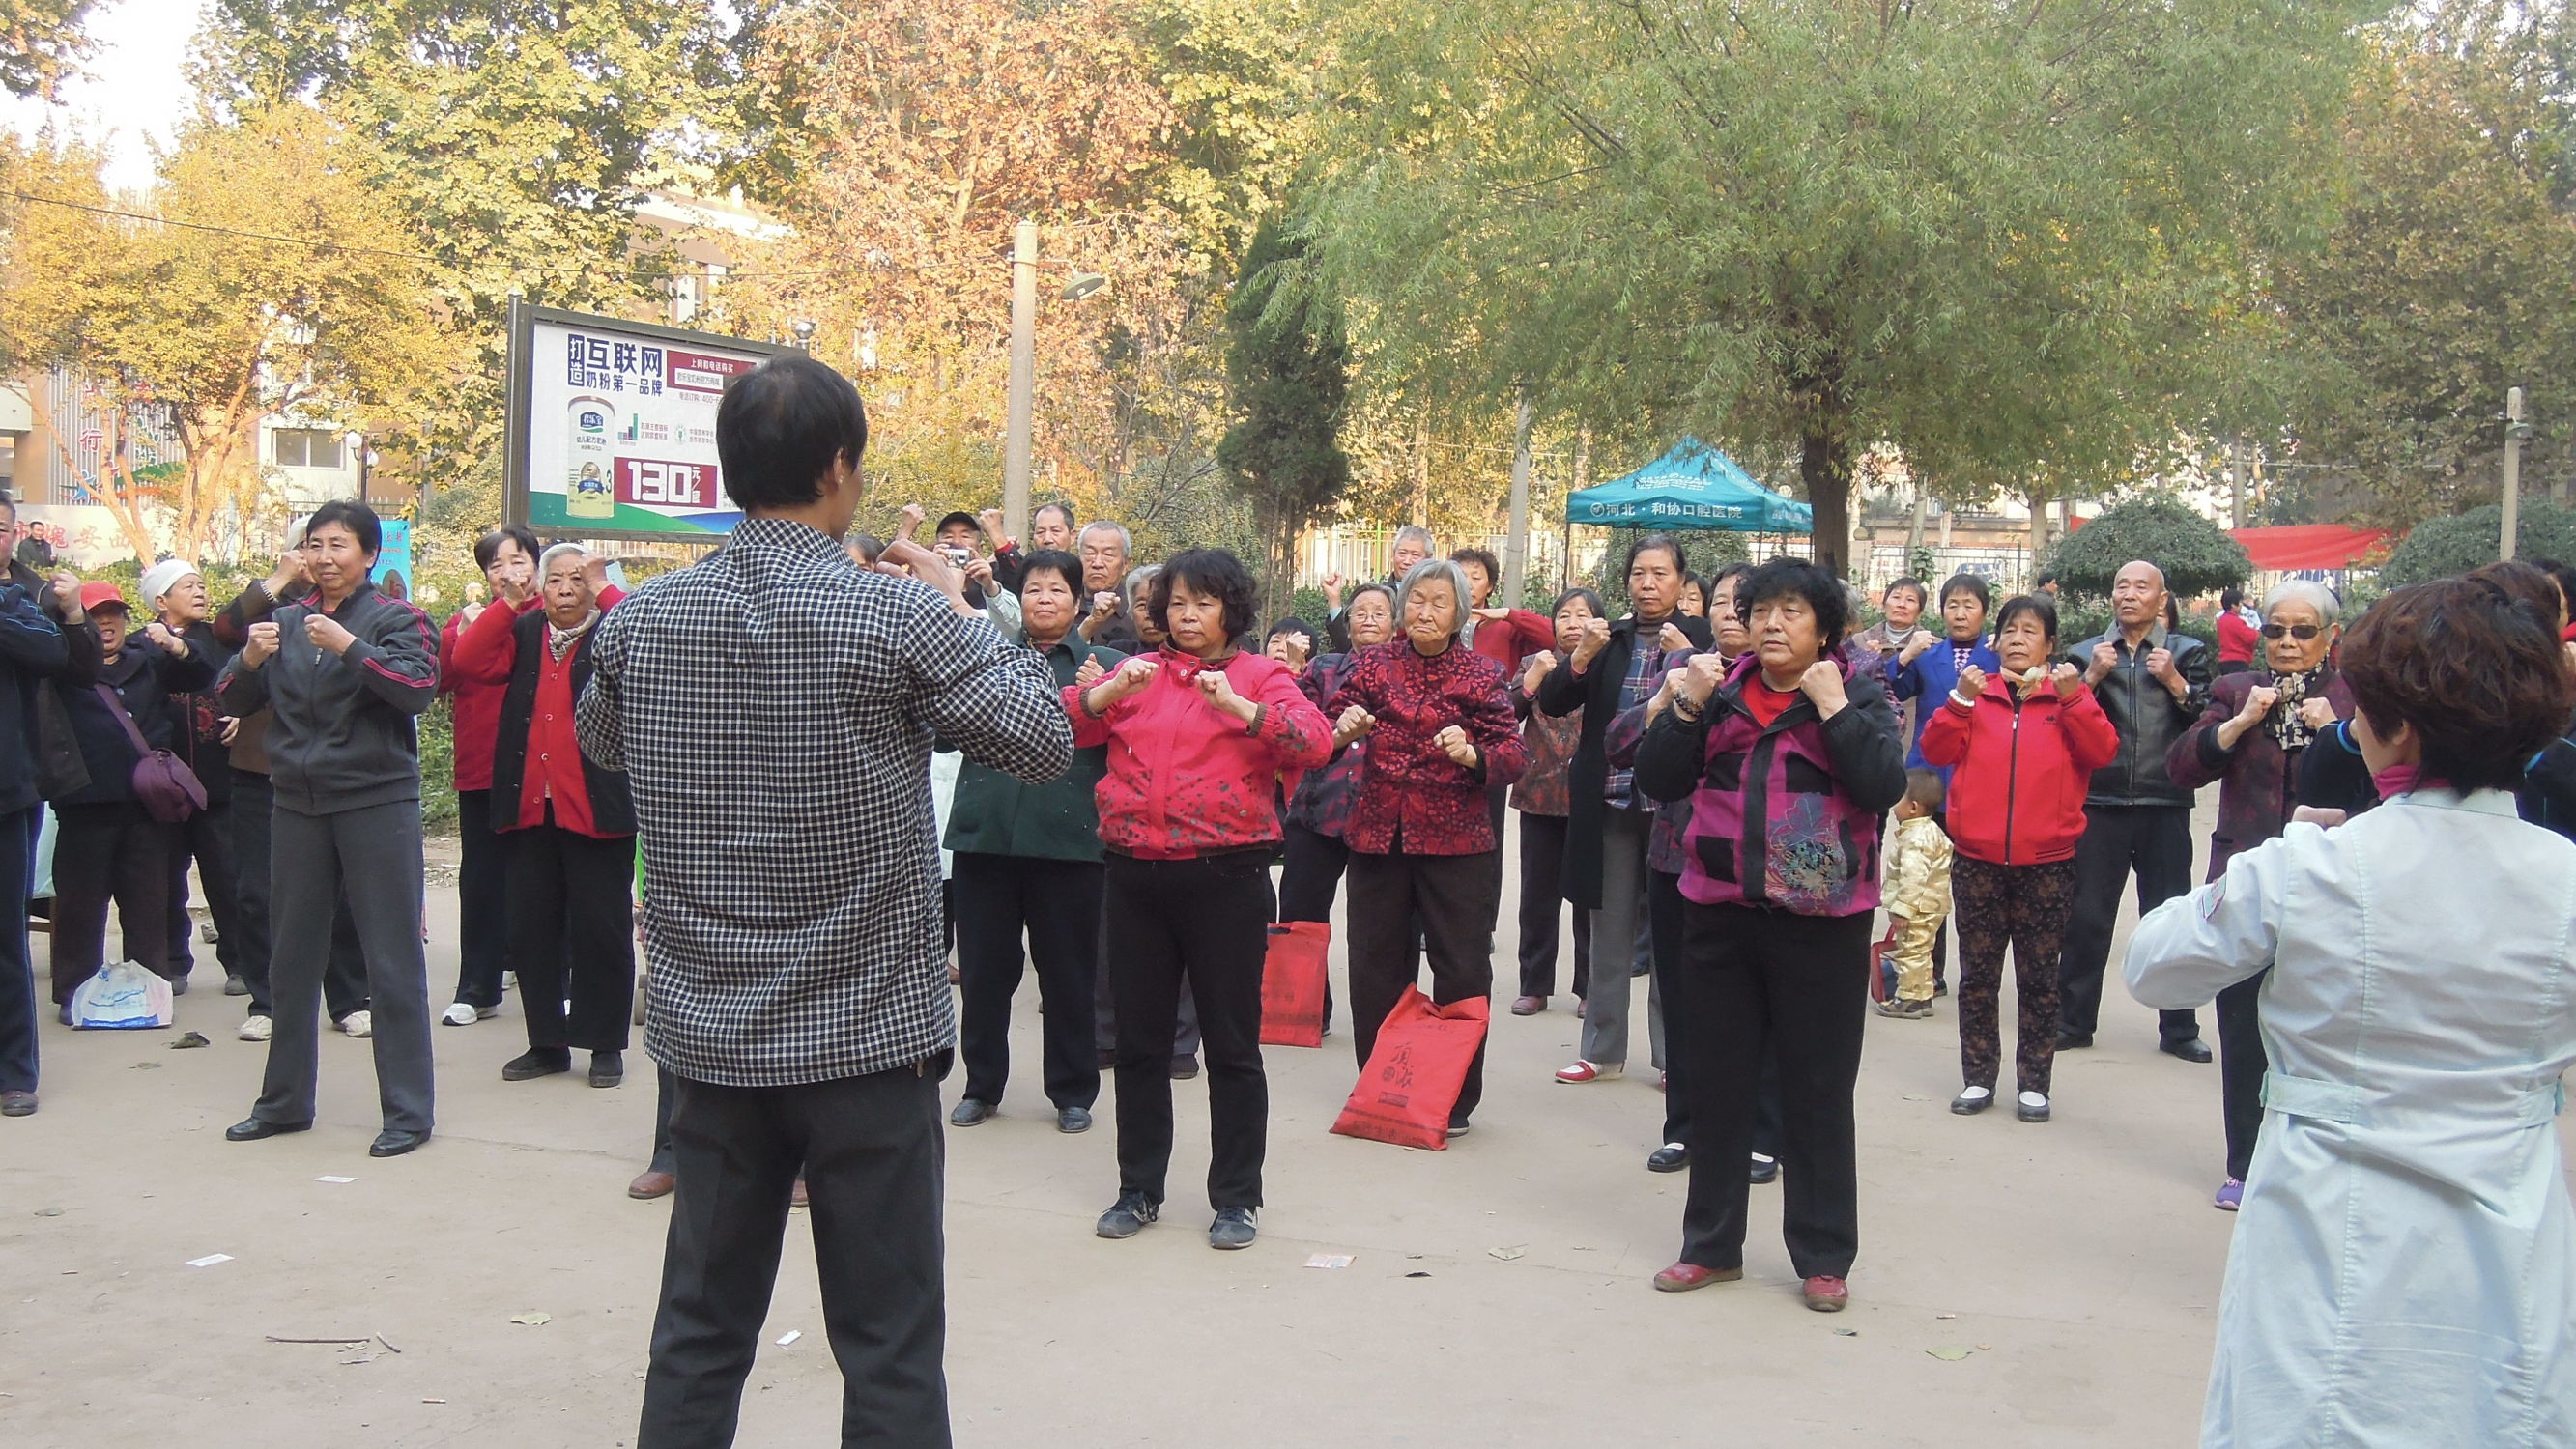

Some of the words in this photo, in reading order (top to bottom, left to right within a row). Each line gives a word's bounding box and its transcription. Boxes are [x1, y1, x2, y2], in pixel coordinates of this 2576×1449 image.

[569, 336, 584, 385] 打造
[586, 337, 662, 378] 互联网
[586, 370, 663, 397] 奶粉第一品牌
[605, 469, 613, 494] 3
[627, 461, 693, 504] 130
